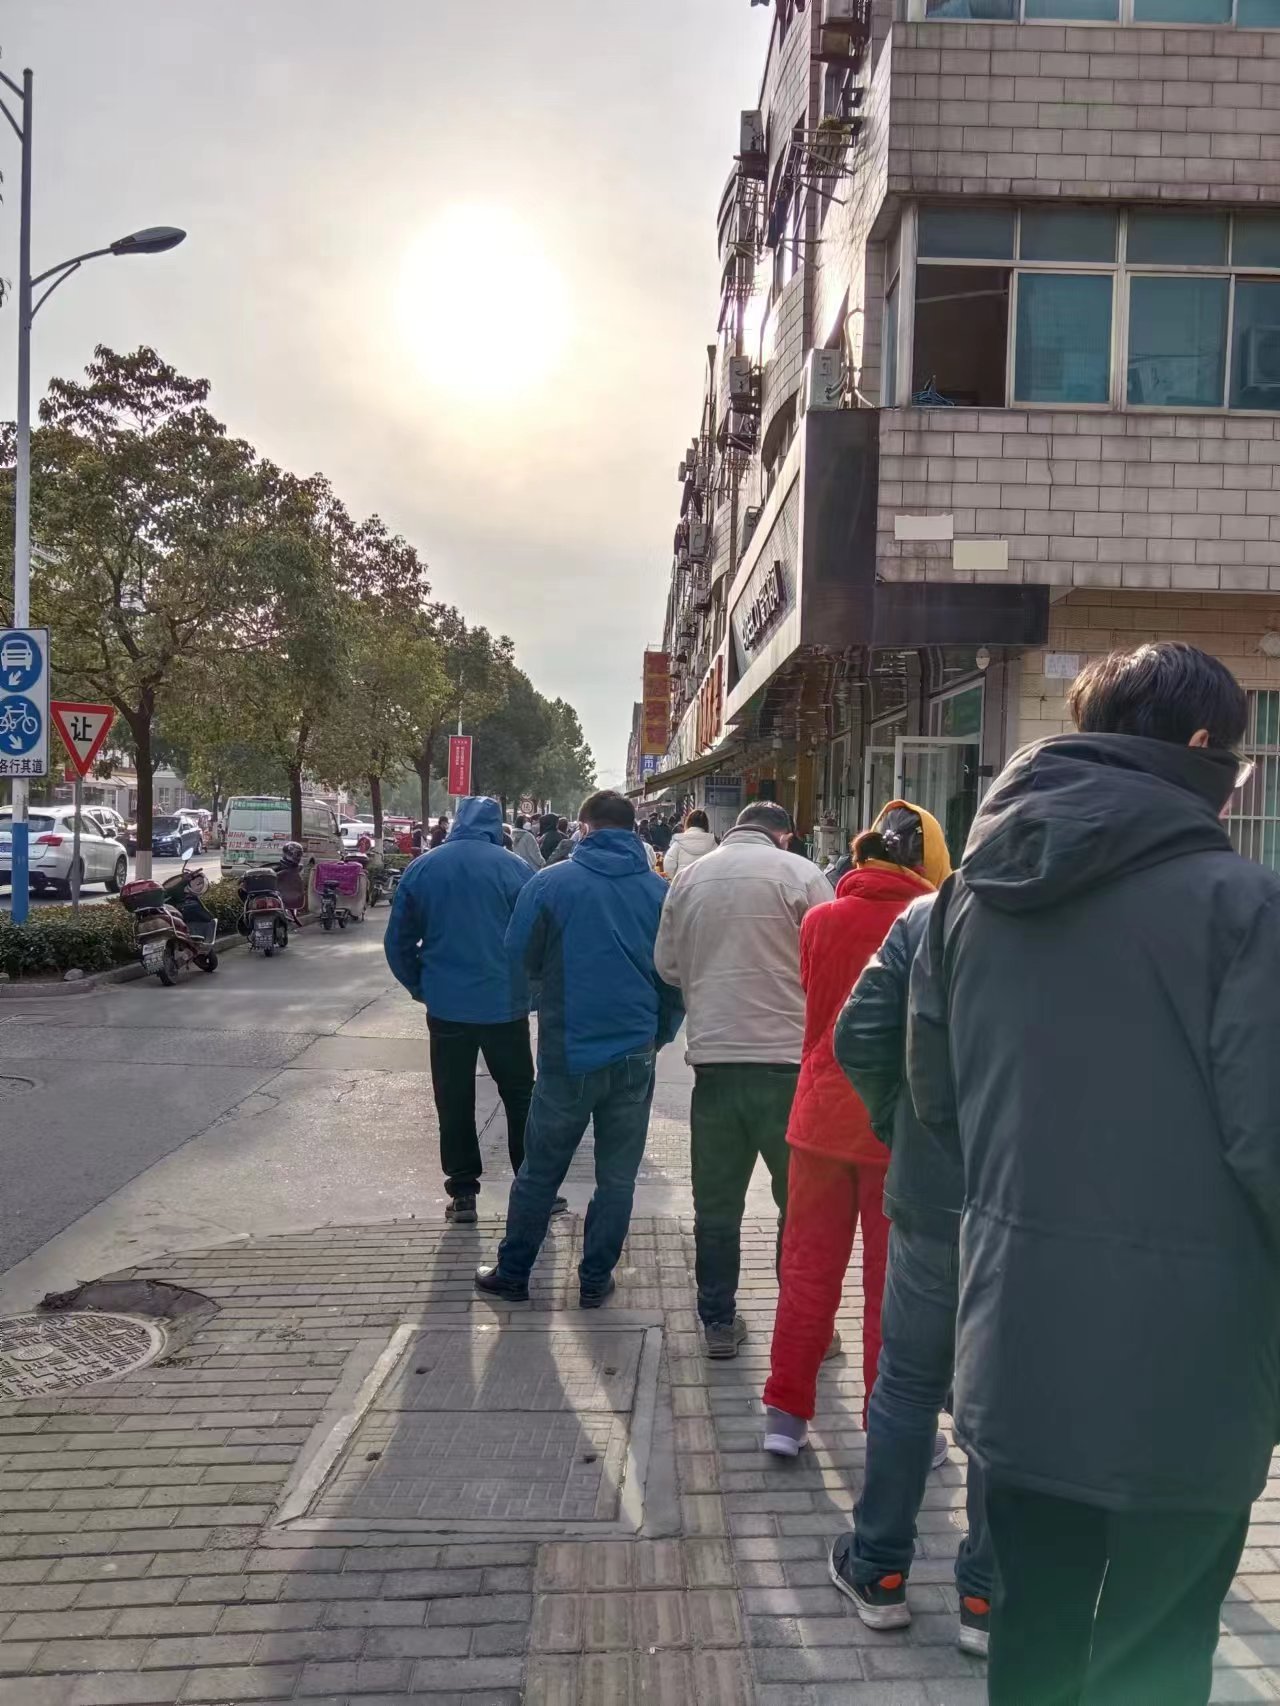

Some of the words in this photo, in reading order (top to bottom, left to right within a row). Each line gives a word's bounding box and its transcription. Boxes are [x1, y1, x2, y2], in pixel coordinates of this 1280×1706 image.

[71, 716, 92, 741] 让
[0, 759, 42, 774] 各行其道
